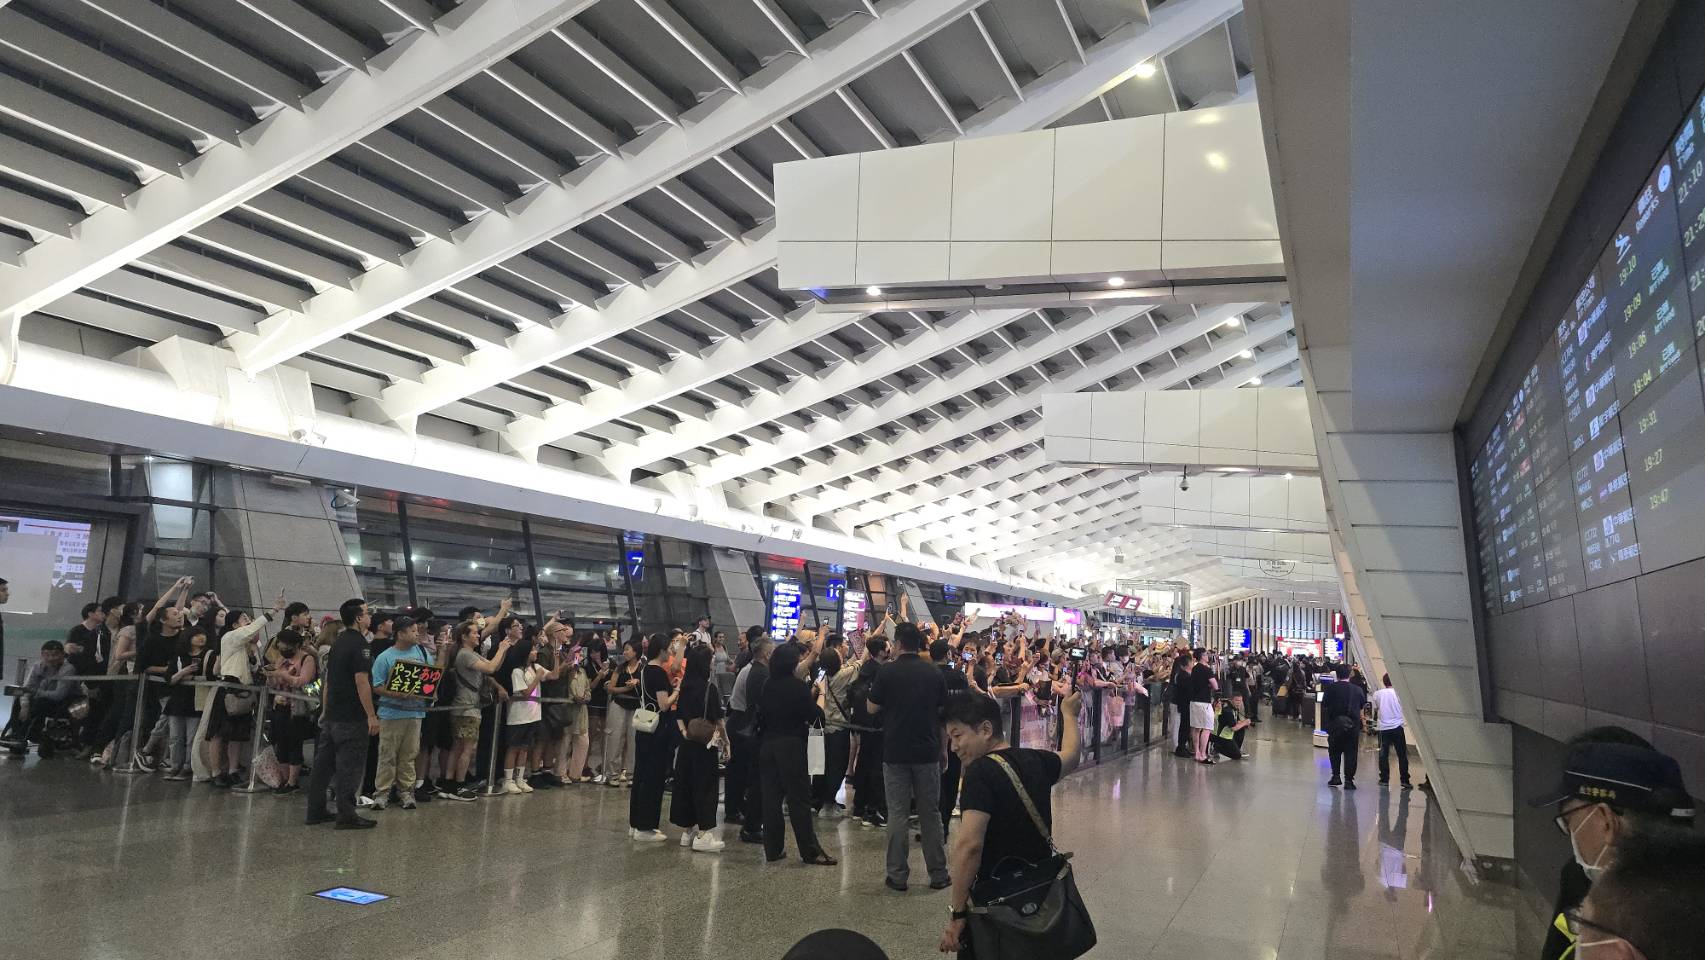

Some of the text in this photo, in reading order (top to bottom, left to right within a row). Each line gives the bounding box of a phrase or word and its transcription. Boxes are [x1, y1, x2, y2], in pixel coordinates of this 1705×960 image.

[1678, 160, 1703, 204] 21:10
[1644, 449, 1663, 472] 19:27
[394, 662, 441, 682] やっとあゆ
[390, 675, 422, 694] 会えた
